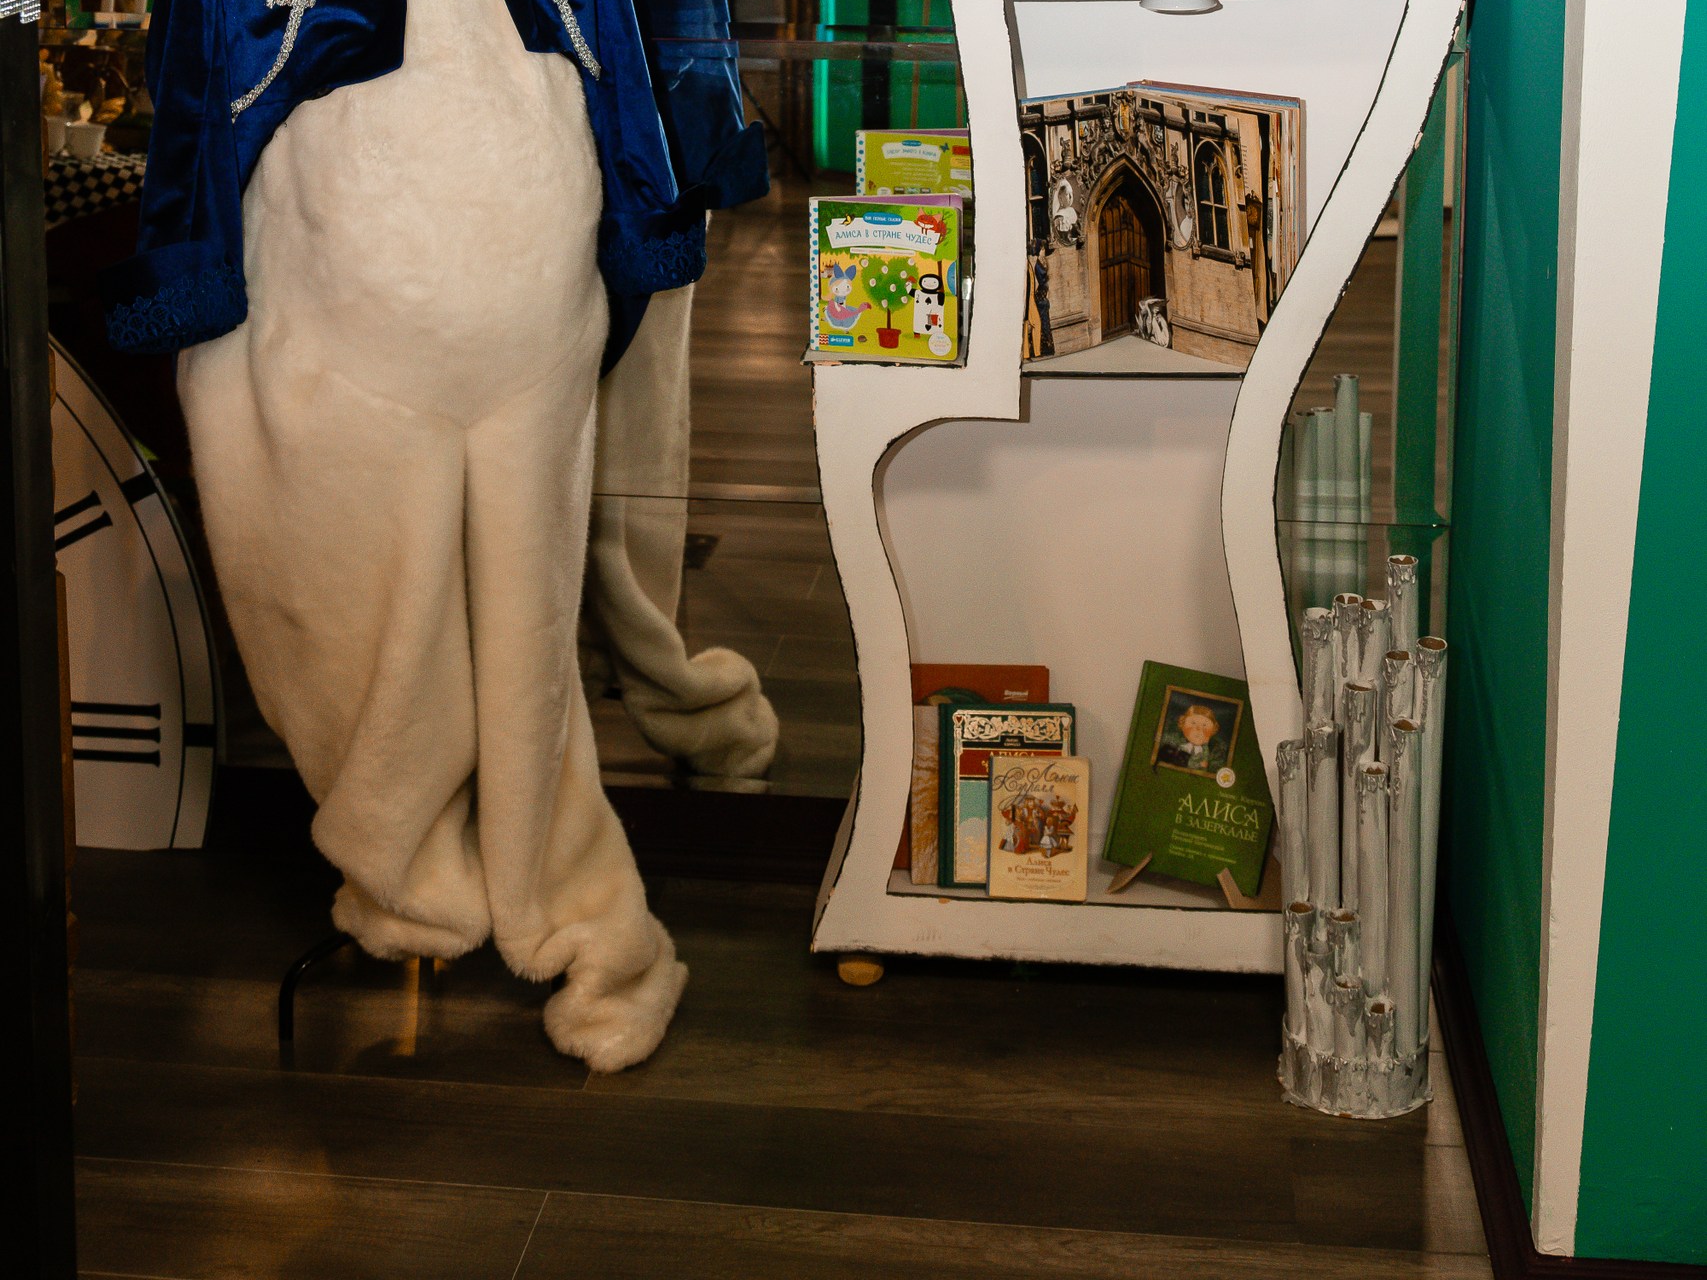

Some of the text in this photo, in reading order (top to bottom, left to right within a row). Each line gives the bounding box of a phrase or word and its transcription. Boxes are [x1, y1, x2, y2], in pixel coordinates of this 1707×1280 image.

[835, 230, 862, 240] АЛИСА
[872, 230, 901, 239] СТРАНЕ
[905, 233, 932, 245] ЧУДЕС
[1178, 793, 1260, 830] АЛИСА
[1175, 814, 1183, 824] В
[1186, 817, 1259, 843] ЗАЗЕРКАЛЬЕ
